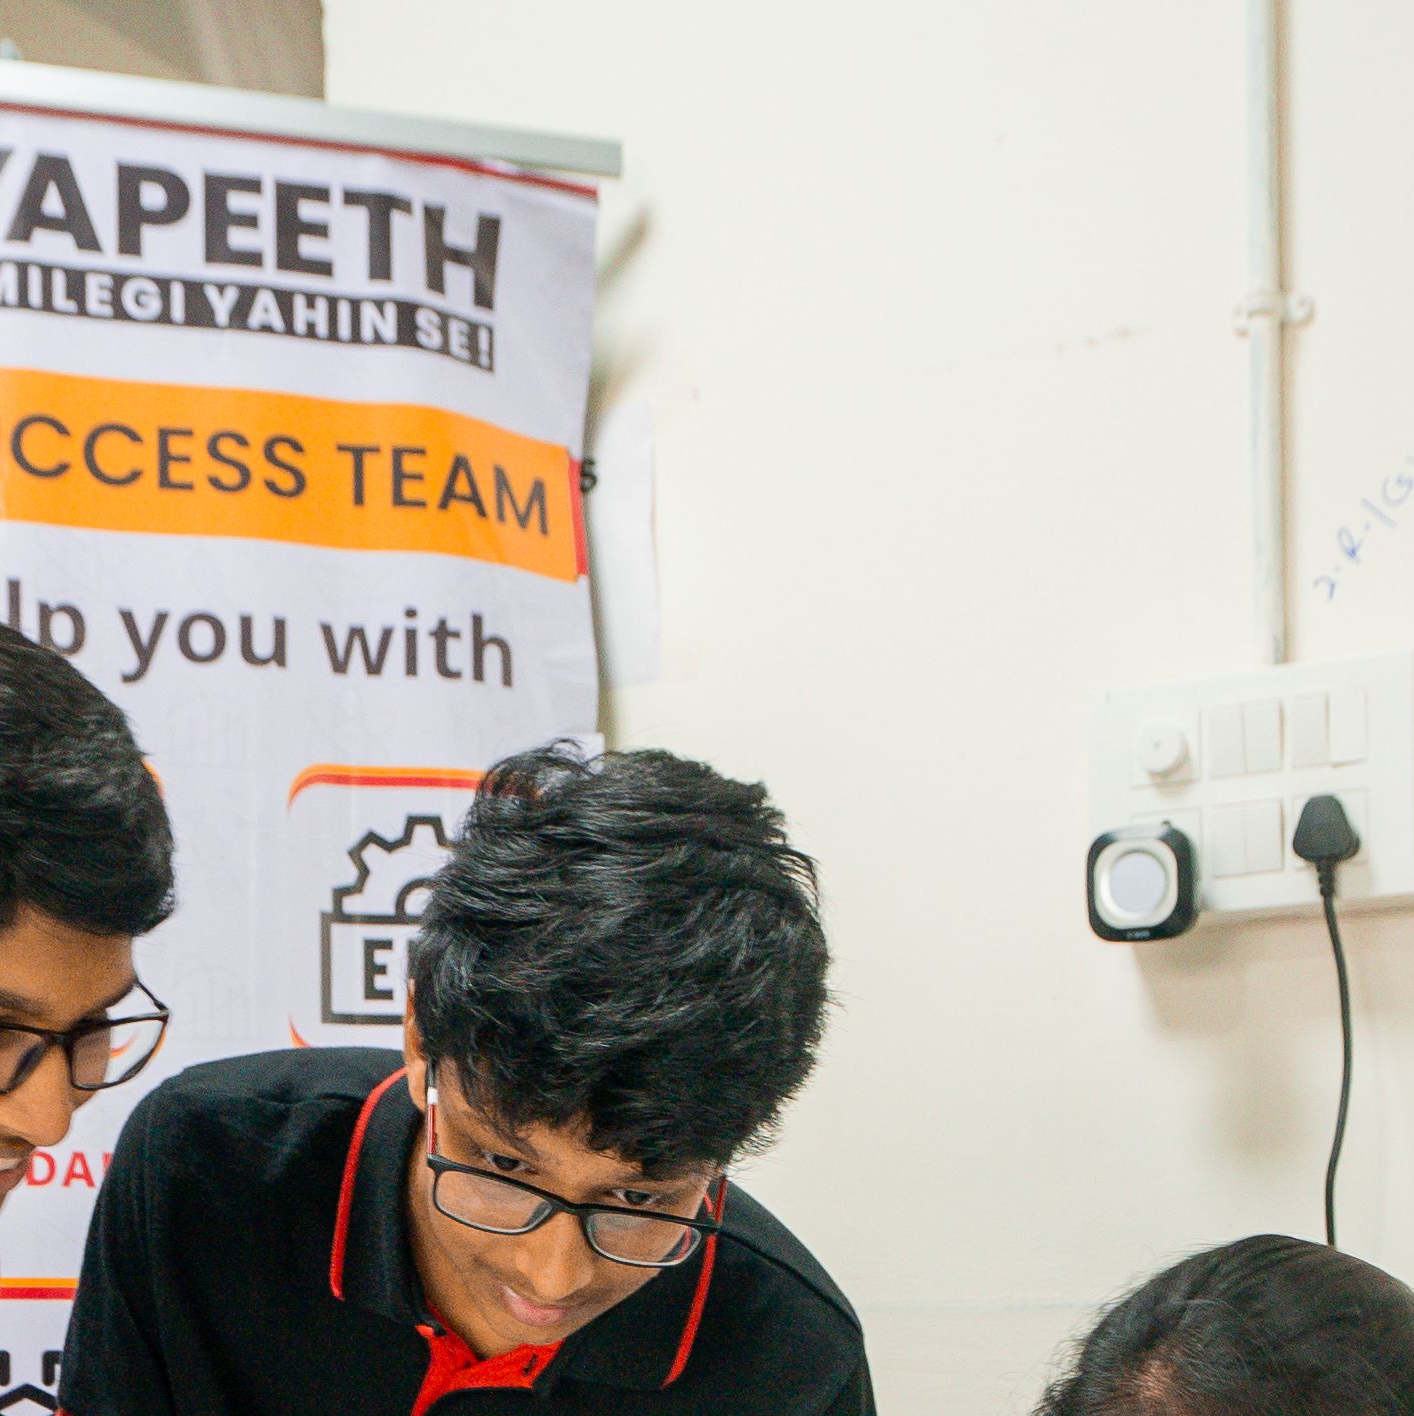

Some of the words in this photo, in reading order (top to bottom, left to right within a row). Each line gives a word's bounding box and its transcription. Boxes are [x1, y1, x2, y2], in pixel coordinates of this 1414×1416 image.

[202, 281, 398, 344] YAHIN
[337, 444, 550, 536] TEAM
[118, 601, 286, 684] you
[320, 606, 514, 688] with
[24, 1150, 113, 1188] DA
